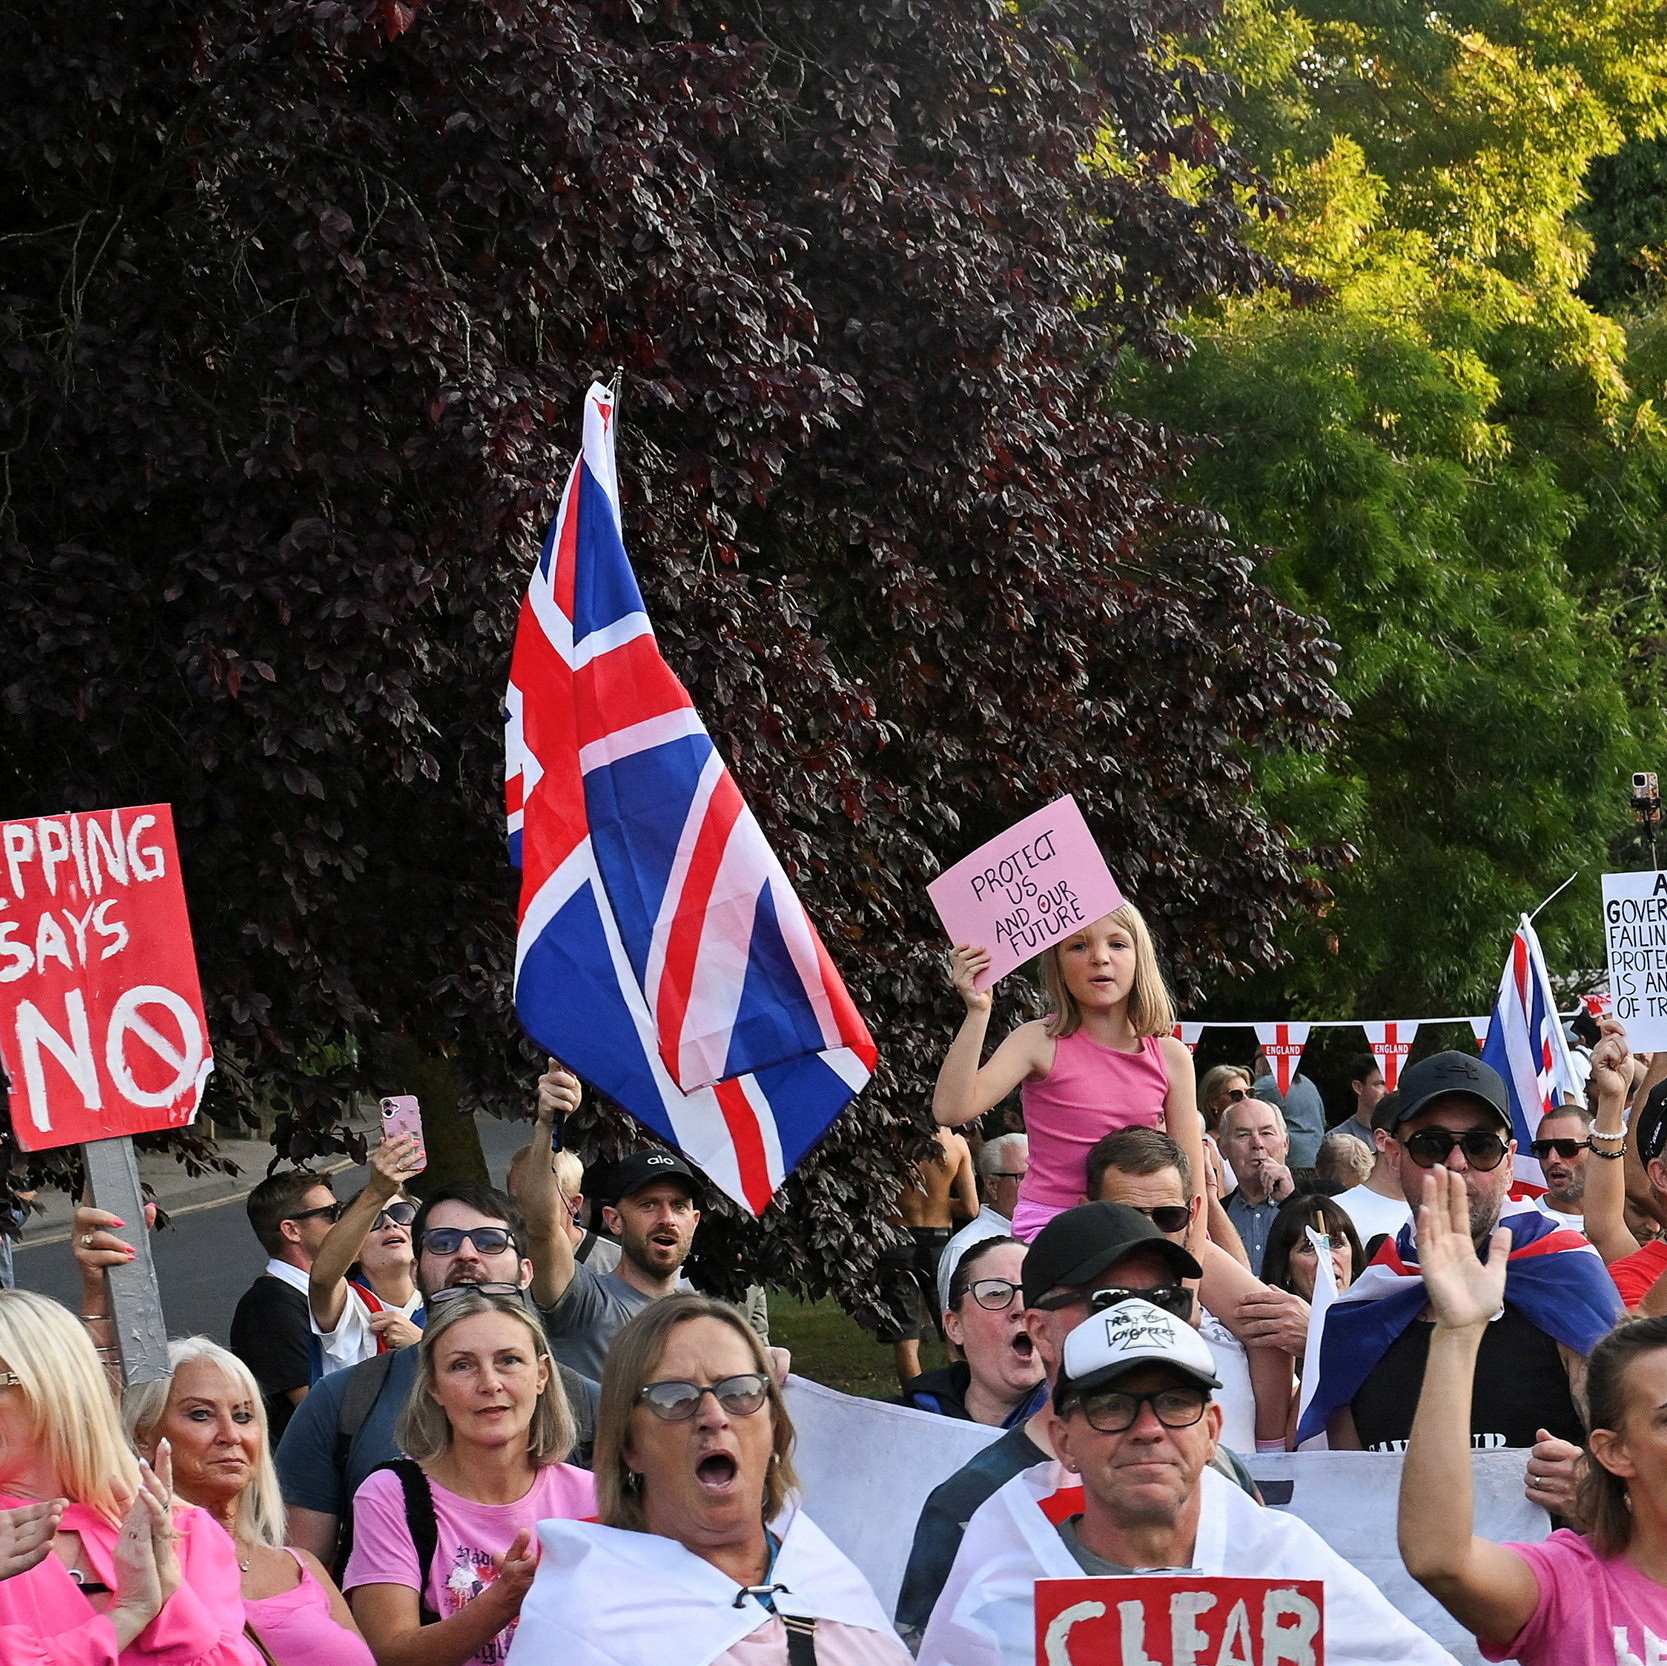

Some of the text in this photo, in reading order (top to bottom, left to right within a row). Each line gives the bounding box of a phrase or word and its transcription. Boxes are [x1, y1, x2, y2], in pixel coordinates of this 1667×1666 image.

[0, 809, 165, 899] PPING
[971, 830, 1056, 901] PROTECT
[995, 880, 1077, 943] AND OUR
[1006, 875, 1037, 905] US
[0, 899, 129, 982] SAYS
[1009, 898, 1085, 956] FUTURE
[1616, 973, 1636, 996] IS
[1617, 996, 1640, 1019] OF
[15, 985, 203, 1132] NO
[1266, 1045, 1301, 1055] ENGLAND
[1375, 1044, 1409, 1054] ENGLAND
[647, 1155, 675, 1165] alo
